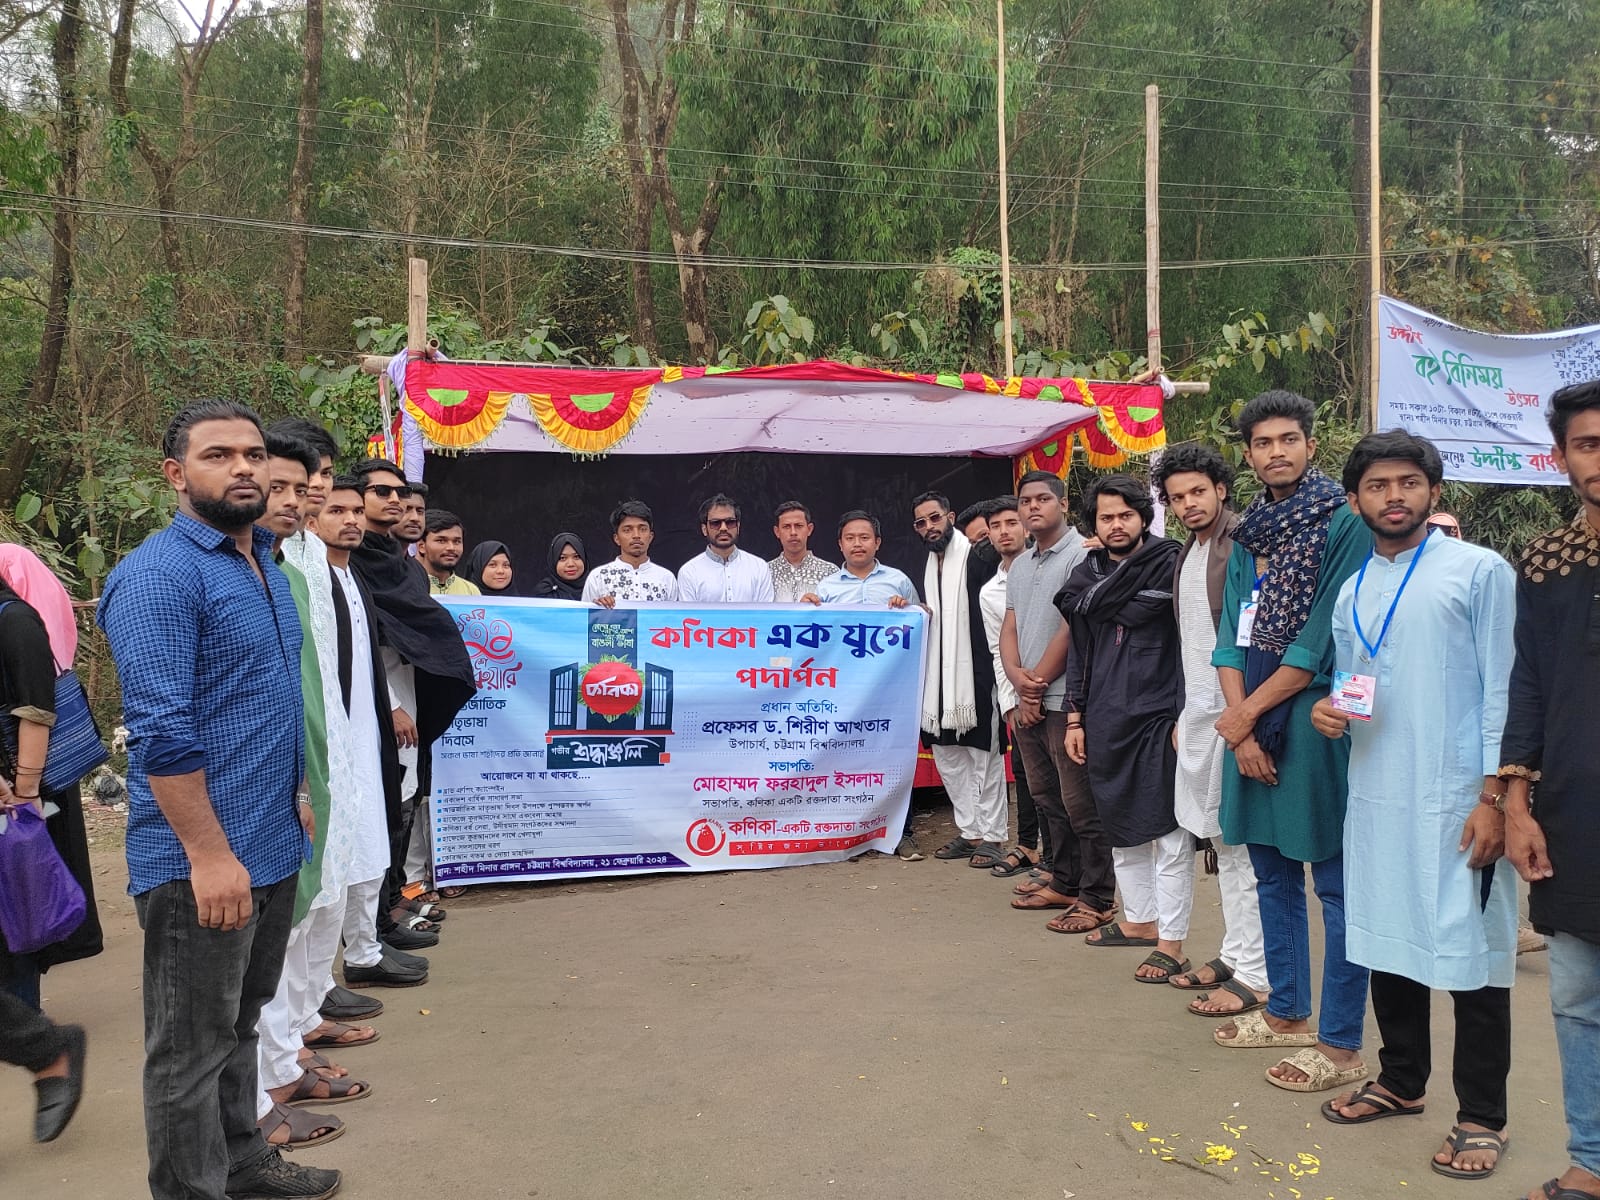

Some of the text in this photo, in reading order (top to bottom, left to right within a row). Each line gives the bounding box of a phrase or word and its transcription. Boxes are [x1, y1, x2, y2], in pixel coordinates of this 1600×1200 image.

[1411, 348, 1503, 389] বই বিনিময়
[1504, 388, 1539, 407] উৎসব
[1440, 445, 1556, 471] জনেঃ উদ্দীপ্ত বাং
[649, 618, 915, 659] কণিকা এক যুগে
[760, 697, 839, 714] প্রধান অতিথি:
[701, 714, 892, 736] প্রফেসর ড. শিরীণ আখতার
[441, 733, 475, 747] দিবসে
[728, 736, 866, 752] উপাচার্য, চট্টগ্রাম বিশ্ববিদ্যালয়
[551, 746, 570, 756] গভীর
[768, 758, 816, 773] সভাপতি:
[480, 772, 524, 781] আয়োজনে
[527, 771, 535, 781] যা
[539, 771, 548, 780] যা
[693, 769, 886, 794] মোহাম্মদ ফরহাদুল ইসলাম
[702, 791, 875, 810] সভাপতি, কণিকা একটি রক্তদাতা সংগঠন
[814, 822, 856, 833] রক্তদাতা
[859, 814, 888, 830] সংগঠন
[477, 862, 499, 874] মিনার
[600, 859, 610, 867] ২১
[646, 856, 667, 865] ২০২৪
